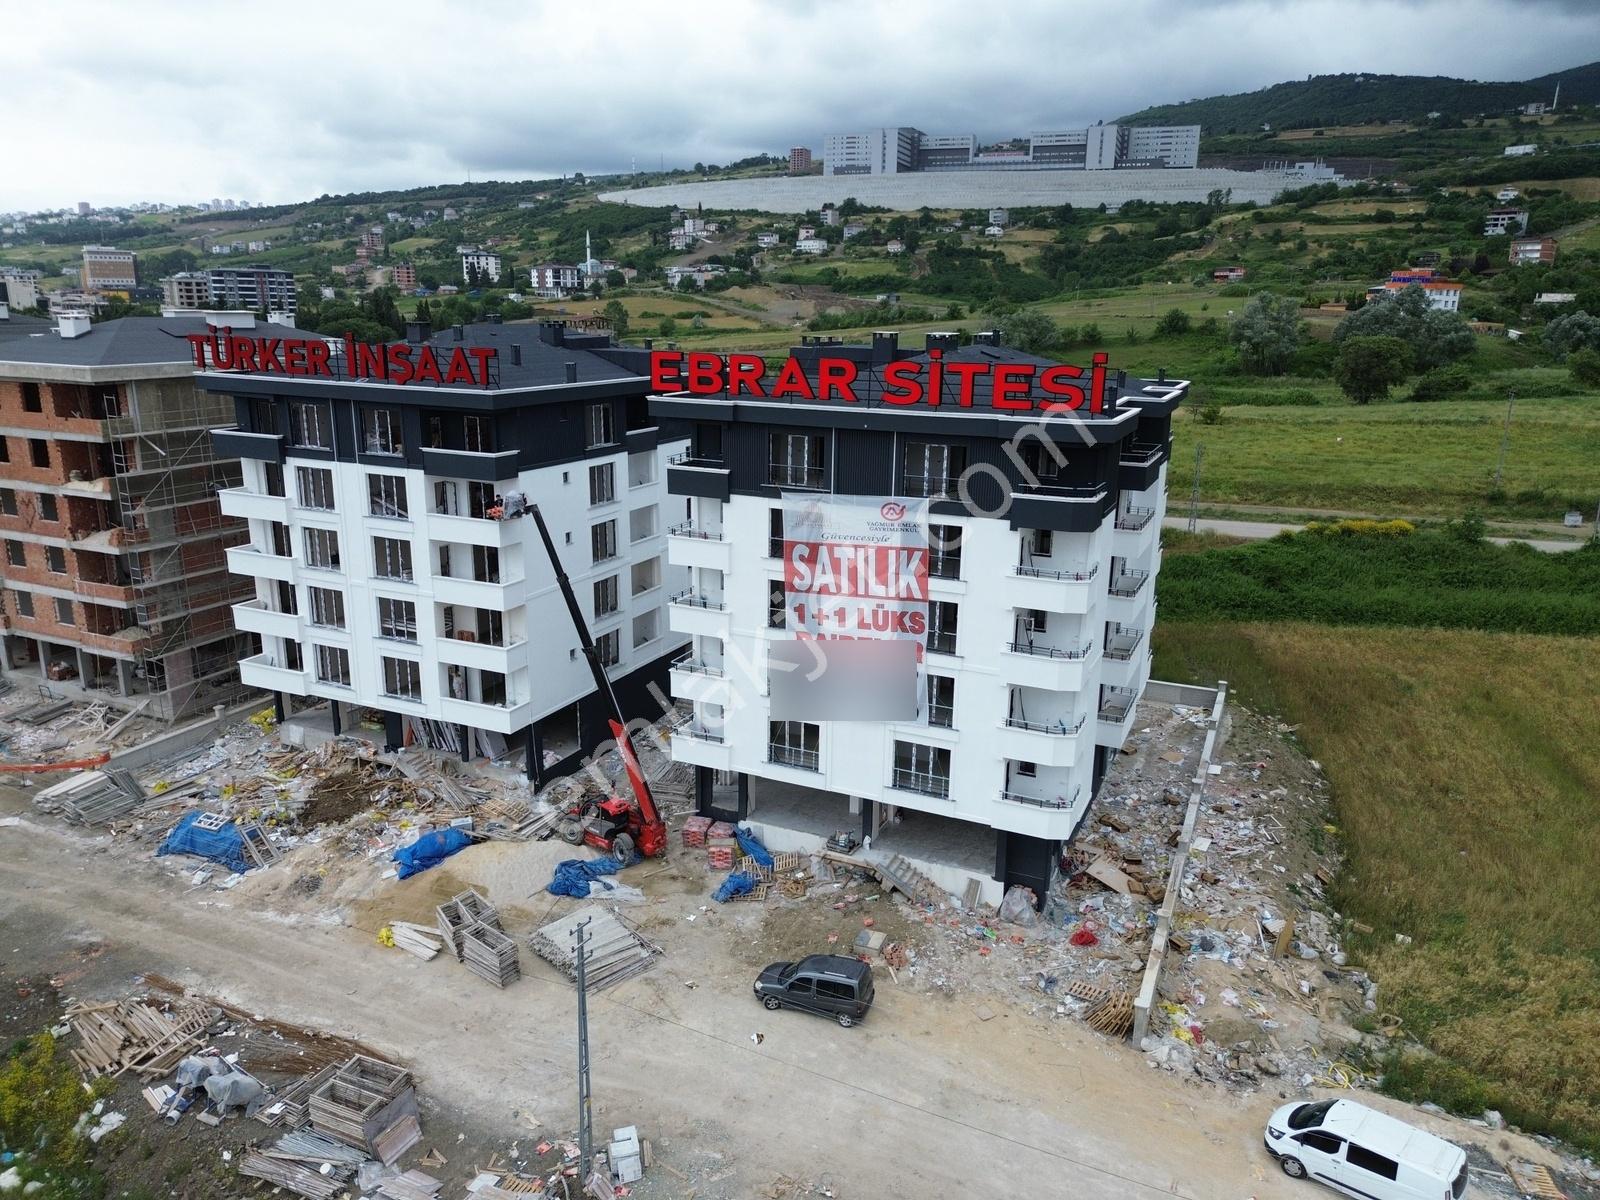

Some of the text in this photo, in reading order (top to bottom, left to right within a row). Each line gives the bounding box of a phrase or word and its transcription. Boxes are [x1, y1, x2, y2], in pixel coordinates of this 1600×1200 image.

[185, 325, 497, 390] TÜRKER İNŞAAT
[649, 348, 1108, 414] EBRAR SİTESİ
[820, 531, 891, 544] Güvencesiyle
[792, 543, 923, 599] SATILIK
[793, 603, 926, 635] 1+1 LÜKS
